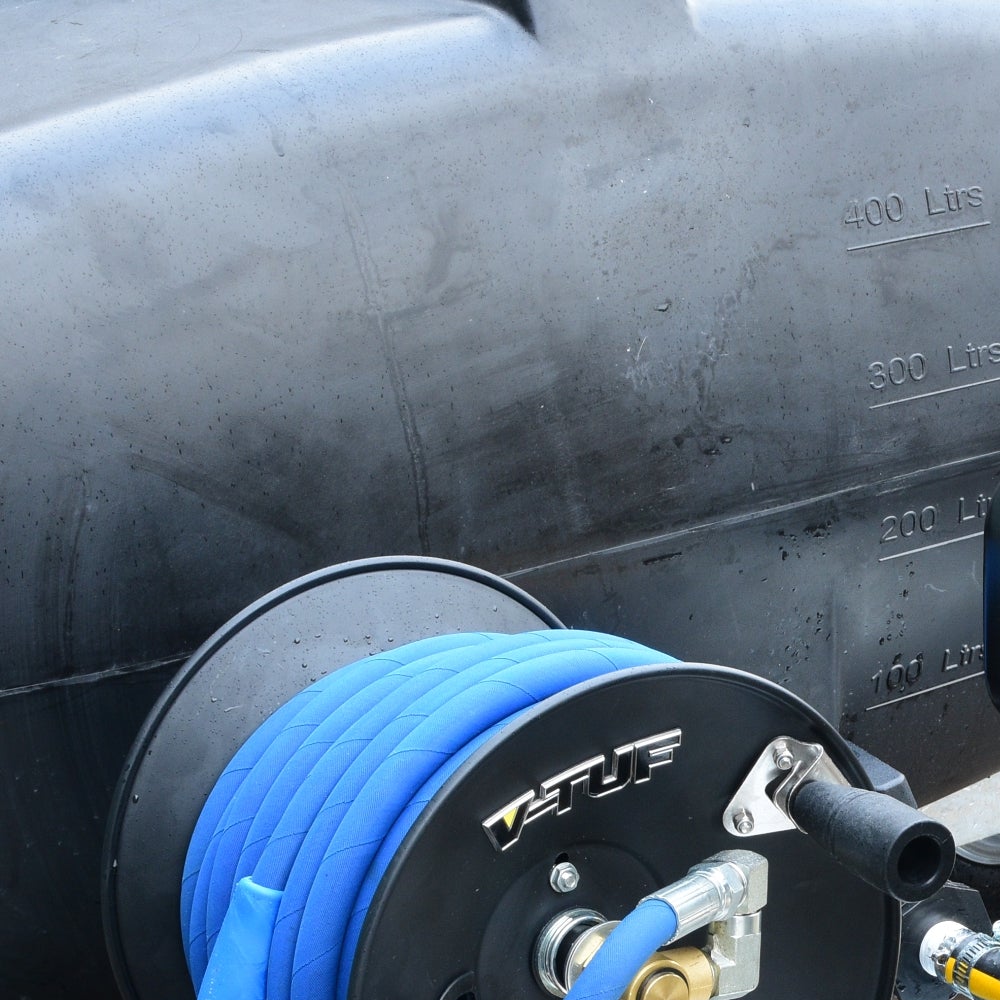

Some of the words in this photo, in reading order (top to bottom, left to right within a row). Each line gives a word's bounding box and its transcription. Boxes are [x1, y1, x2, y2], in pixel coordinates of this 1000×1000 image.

[844, 193, 904, 229] 400
[924, 185, 983, 216] Ltrs
[867, 352, 927, 391] 300
[879, 505, 937, 545] 200
[871, 657, 924, 694] 100
[481, 728, 682, 851] V-TUF
